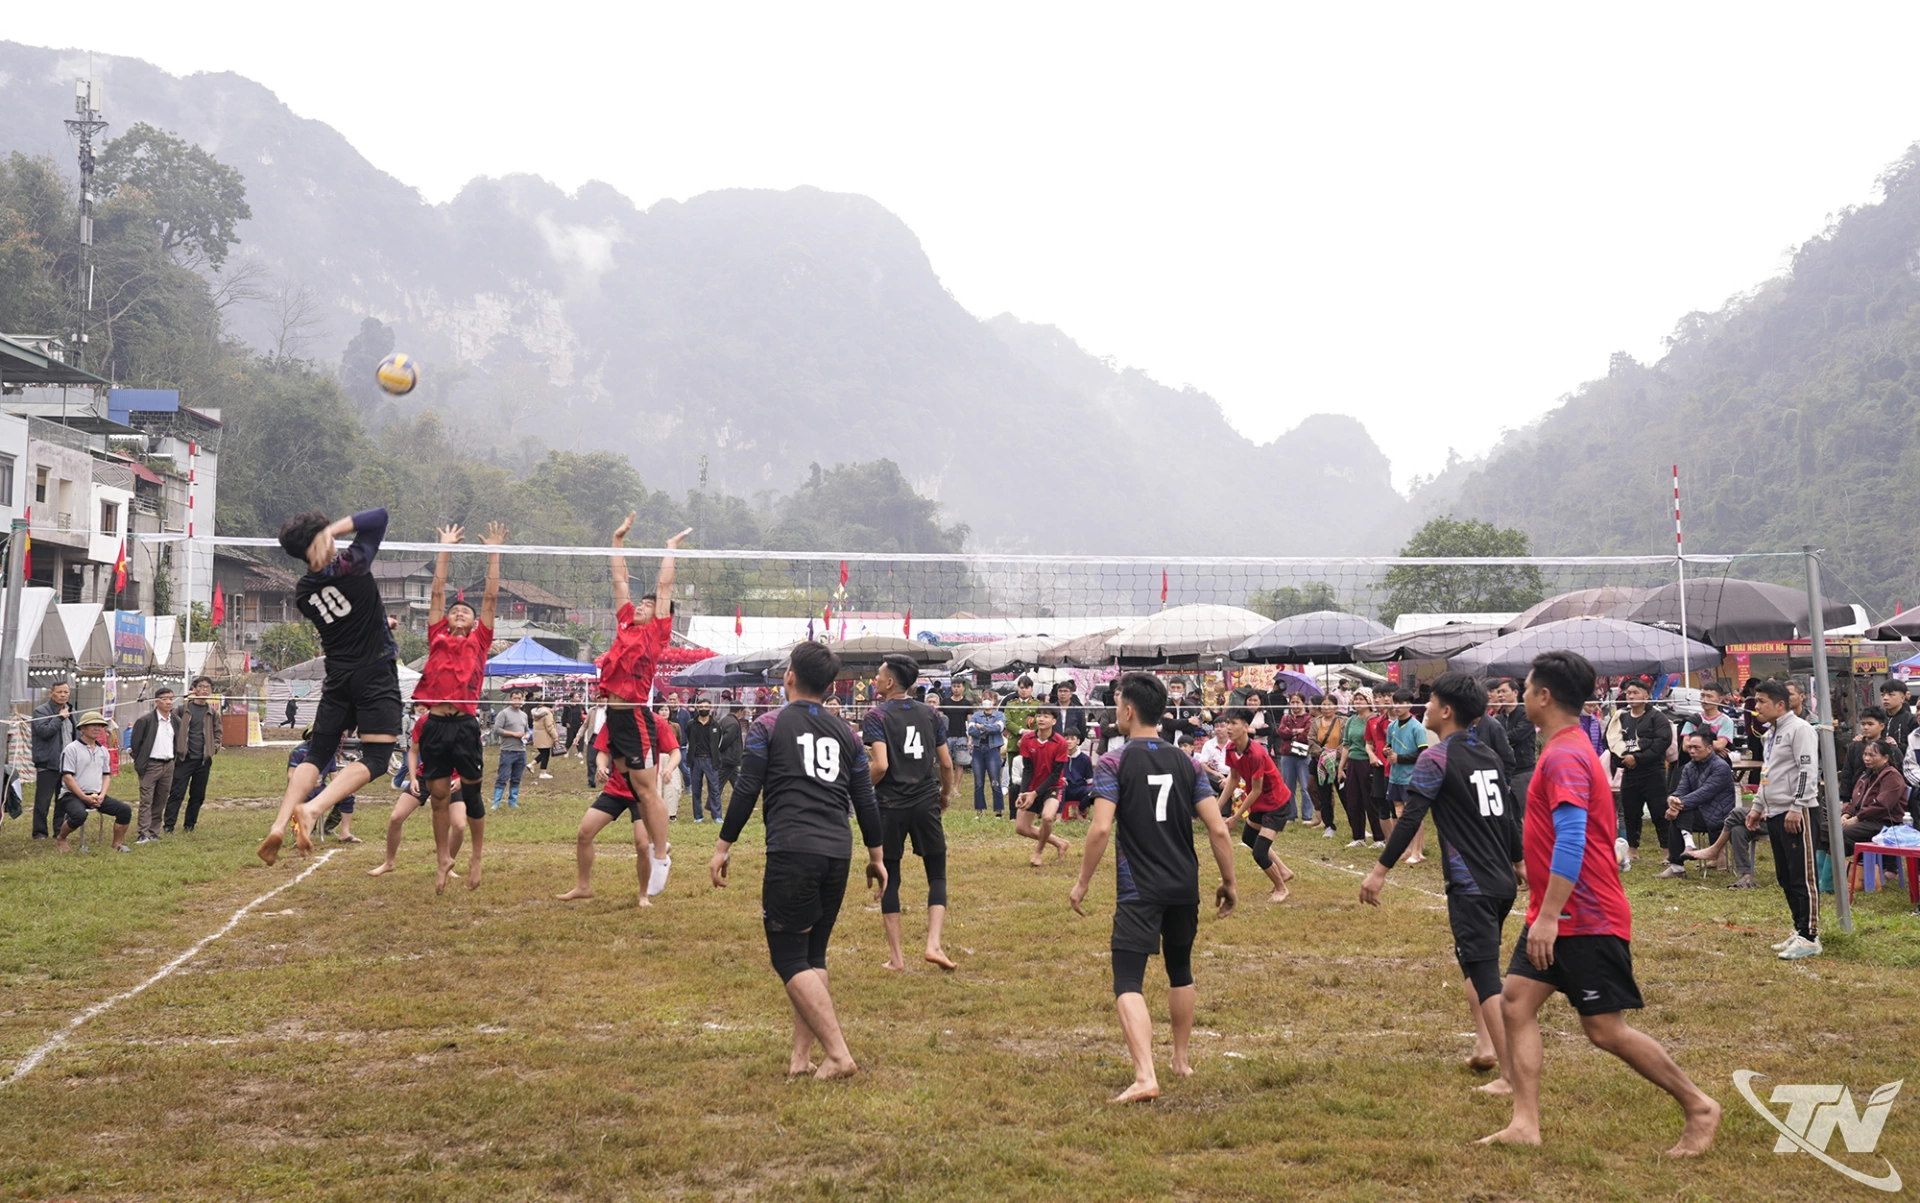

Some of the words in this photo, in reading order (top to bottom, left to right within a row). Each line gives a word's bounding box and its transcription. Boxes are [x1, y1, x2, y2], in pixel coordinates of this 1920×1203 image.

[308, 586, 352, 625] 10
[797, 733, 840, 783] 19
[903, 725, 924, 760] 4
[1147, 773, 1173, 822] 7
[1469, 769, 1504, 817] 15
